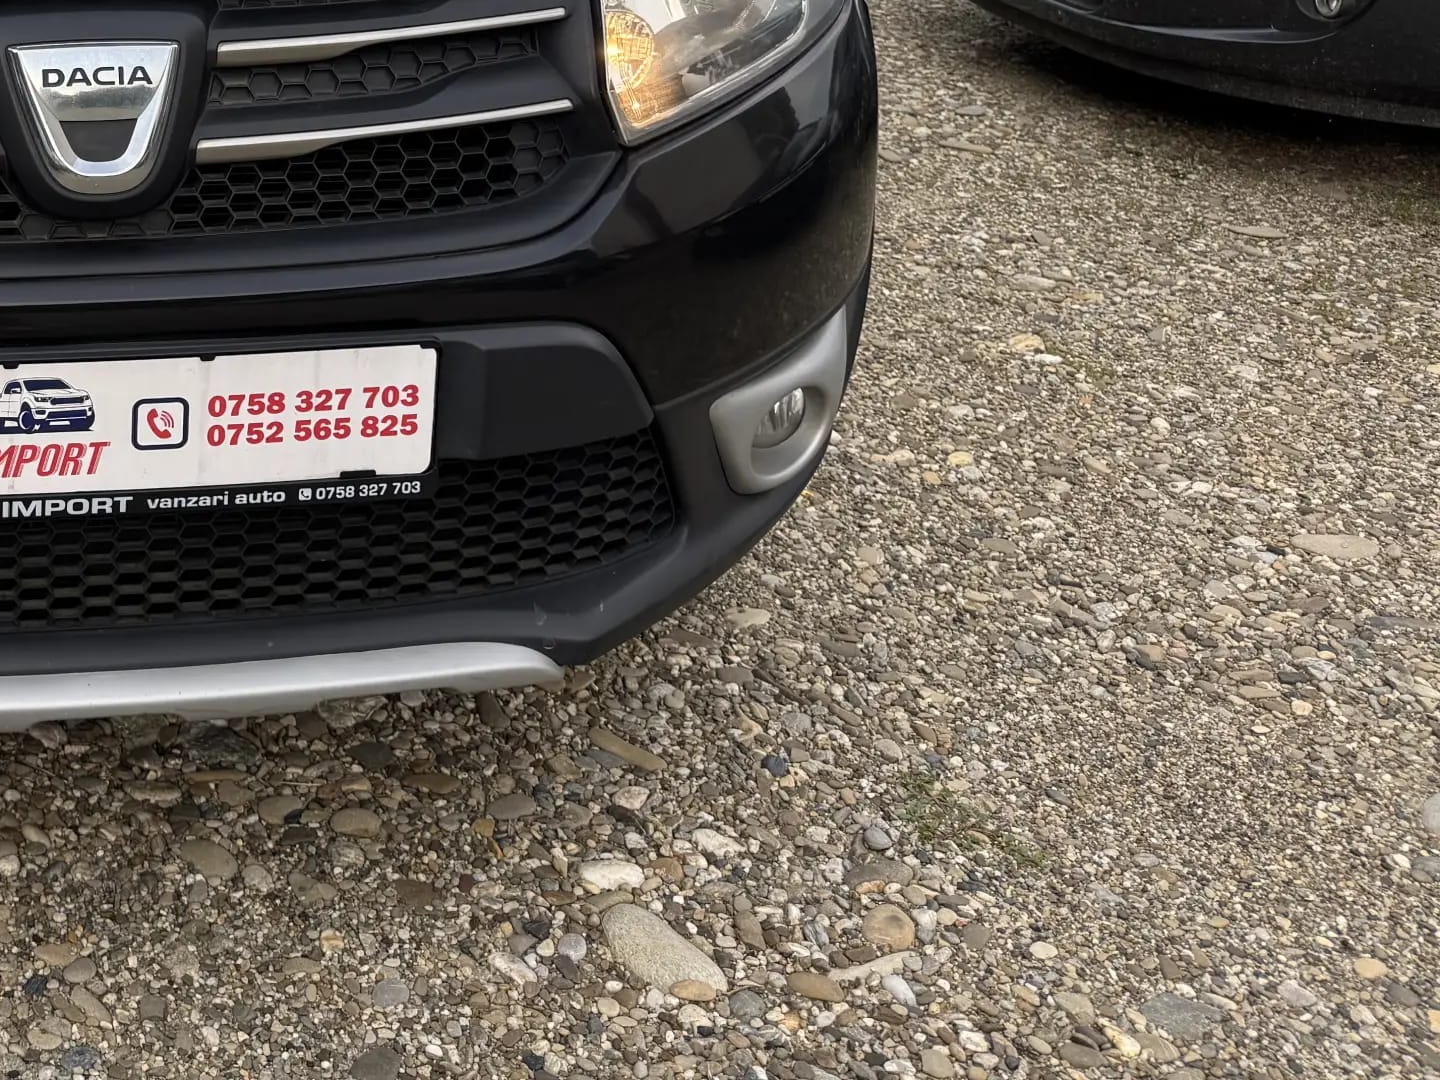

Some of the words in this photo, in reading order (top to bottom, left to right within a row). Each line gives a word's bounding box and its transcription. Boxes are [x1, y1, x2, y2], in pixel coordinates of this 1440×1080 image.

[42, 65, 153, 88] DACIA
[207, 391, 286, 418] 0758
[294, 388, 353, 413] 327
[362, 384, 420, 409] 703
[206, 421, 284, 447] 0752
[293, 417, 352, 442] 565
[360, 414, 418, 438] 825
[2, 496, 134, 519] IMPORT
[146, 491, 229, 510] vanzari
[234, 490, 286, 505] auto
[315, 486, 355, 501] 0758
[359, 483, 387, 497] 327
[392, 481, 421, 496] 703
